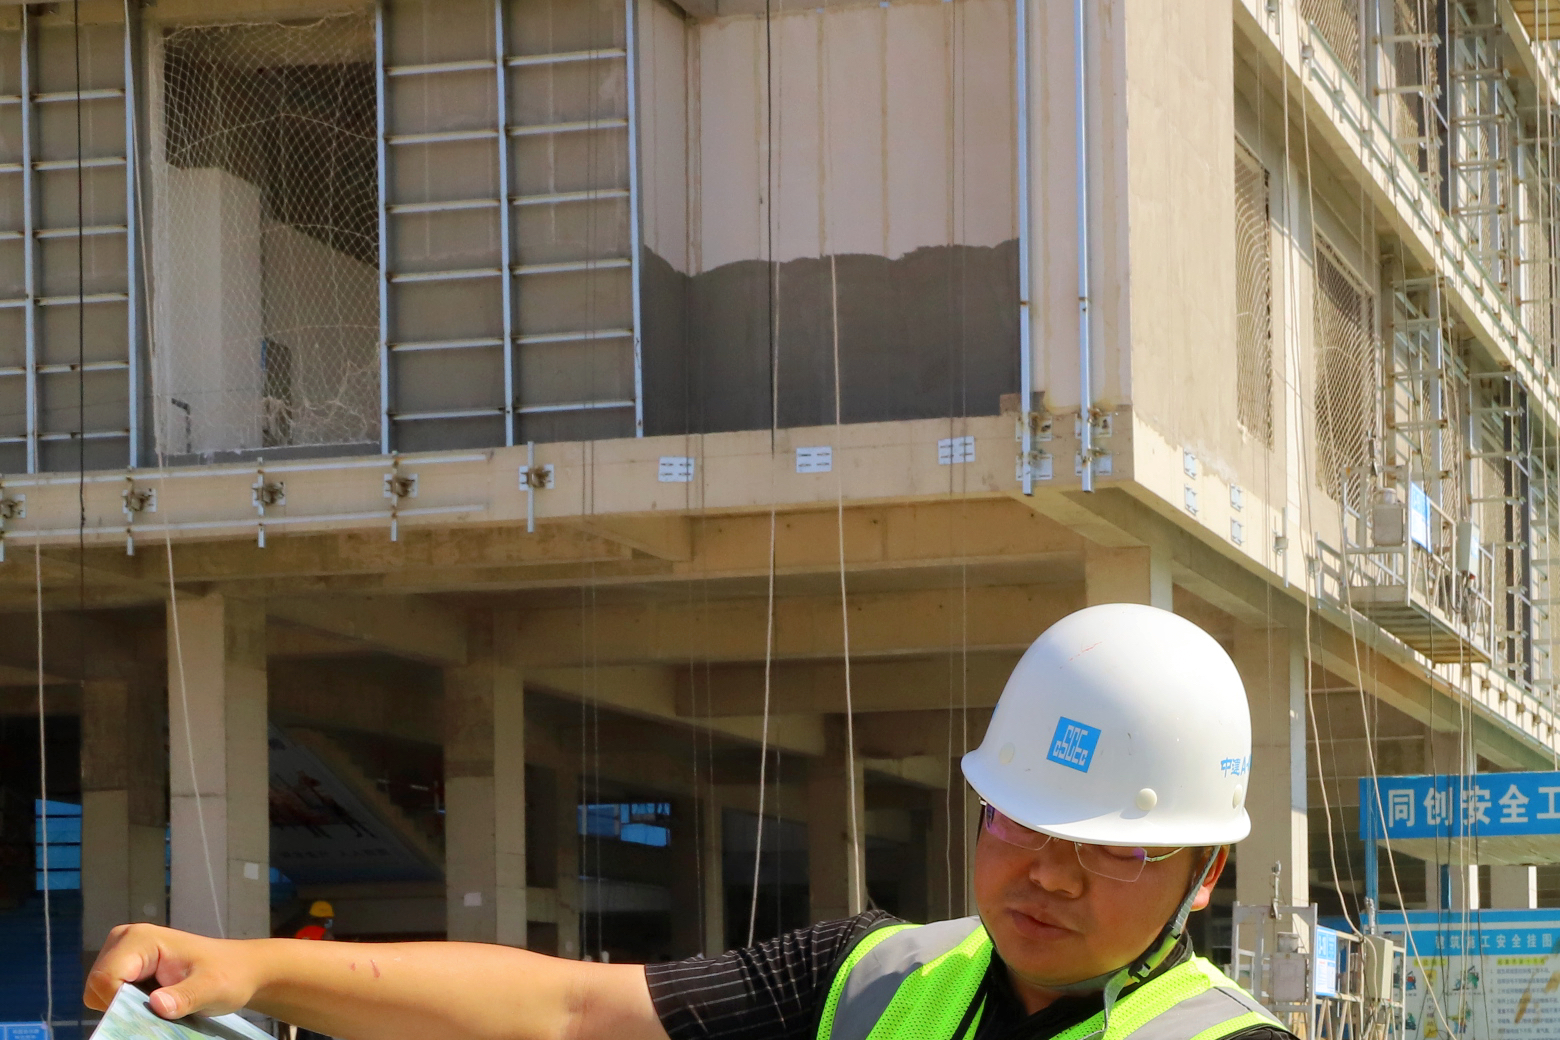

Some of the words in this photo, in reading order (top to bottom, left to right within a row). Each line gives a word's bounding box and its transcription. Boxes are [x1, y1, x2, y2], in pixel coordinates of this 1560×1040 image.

[1435, 933, 1553, 950] 建筑施工安全挂图
